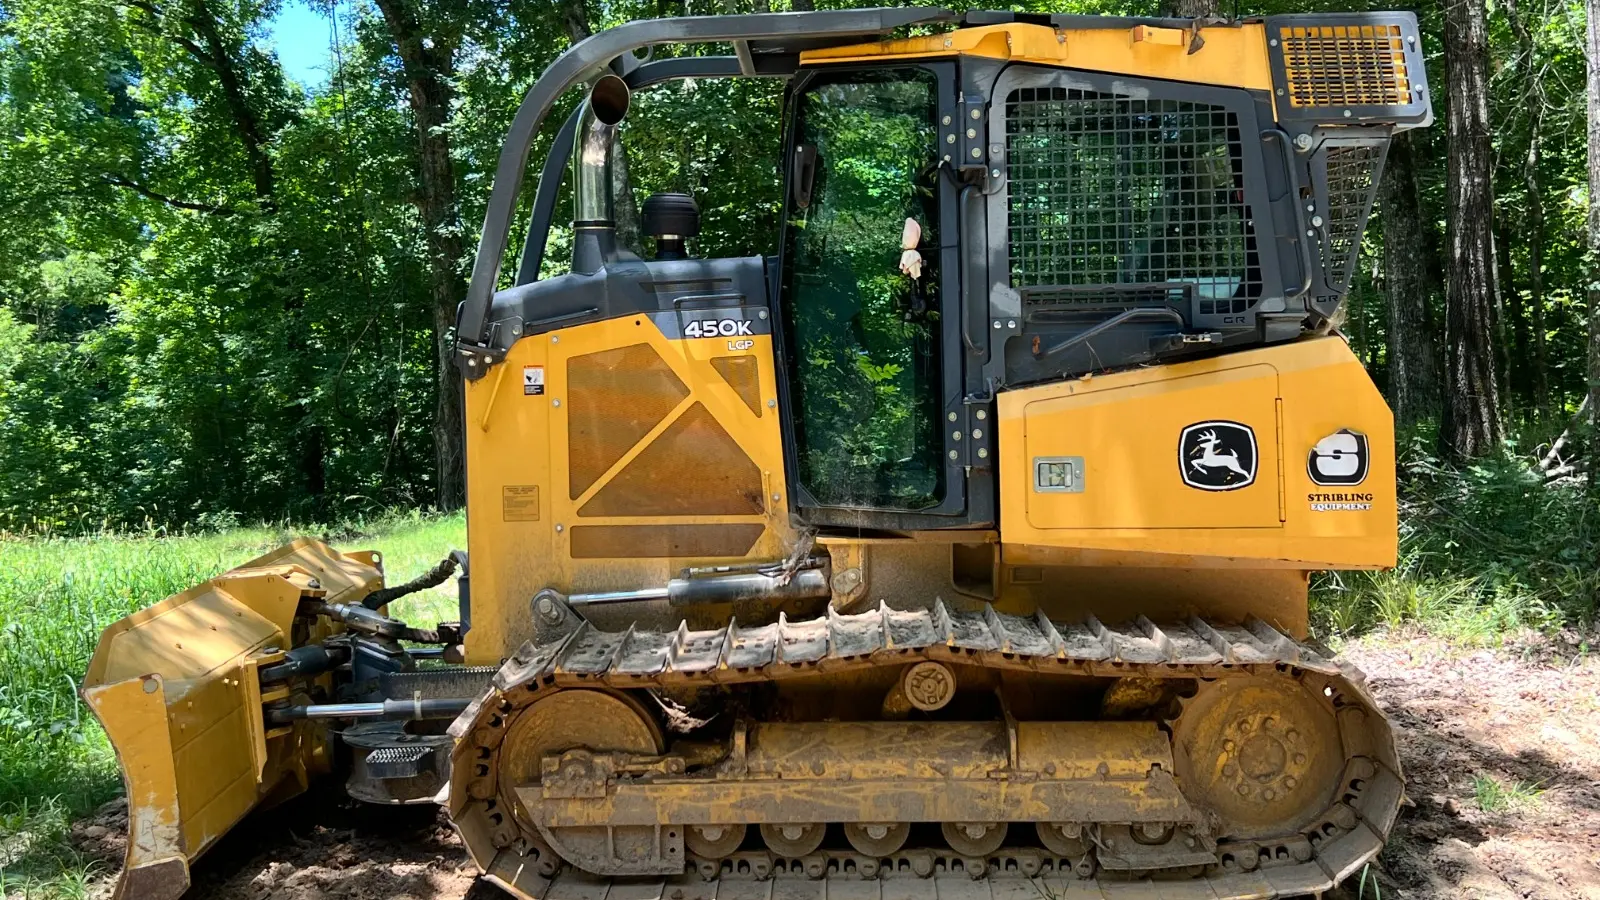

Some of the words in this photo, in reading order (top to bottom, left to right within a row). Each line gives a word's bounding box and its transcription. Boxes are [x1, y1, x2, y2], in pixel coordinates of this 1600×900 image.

[684, 319, 754, 338] 450K
[728, 340, 754, 351] LGP
[1308, 493, 1373, 502] STRIBLING
[1310, 503, 1372, 512] EQUIPMENT
